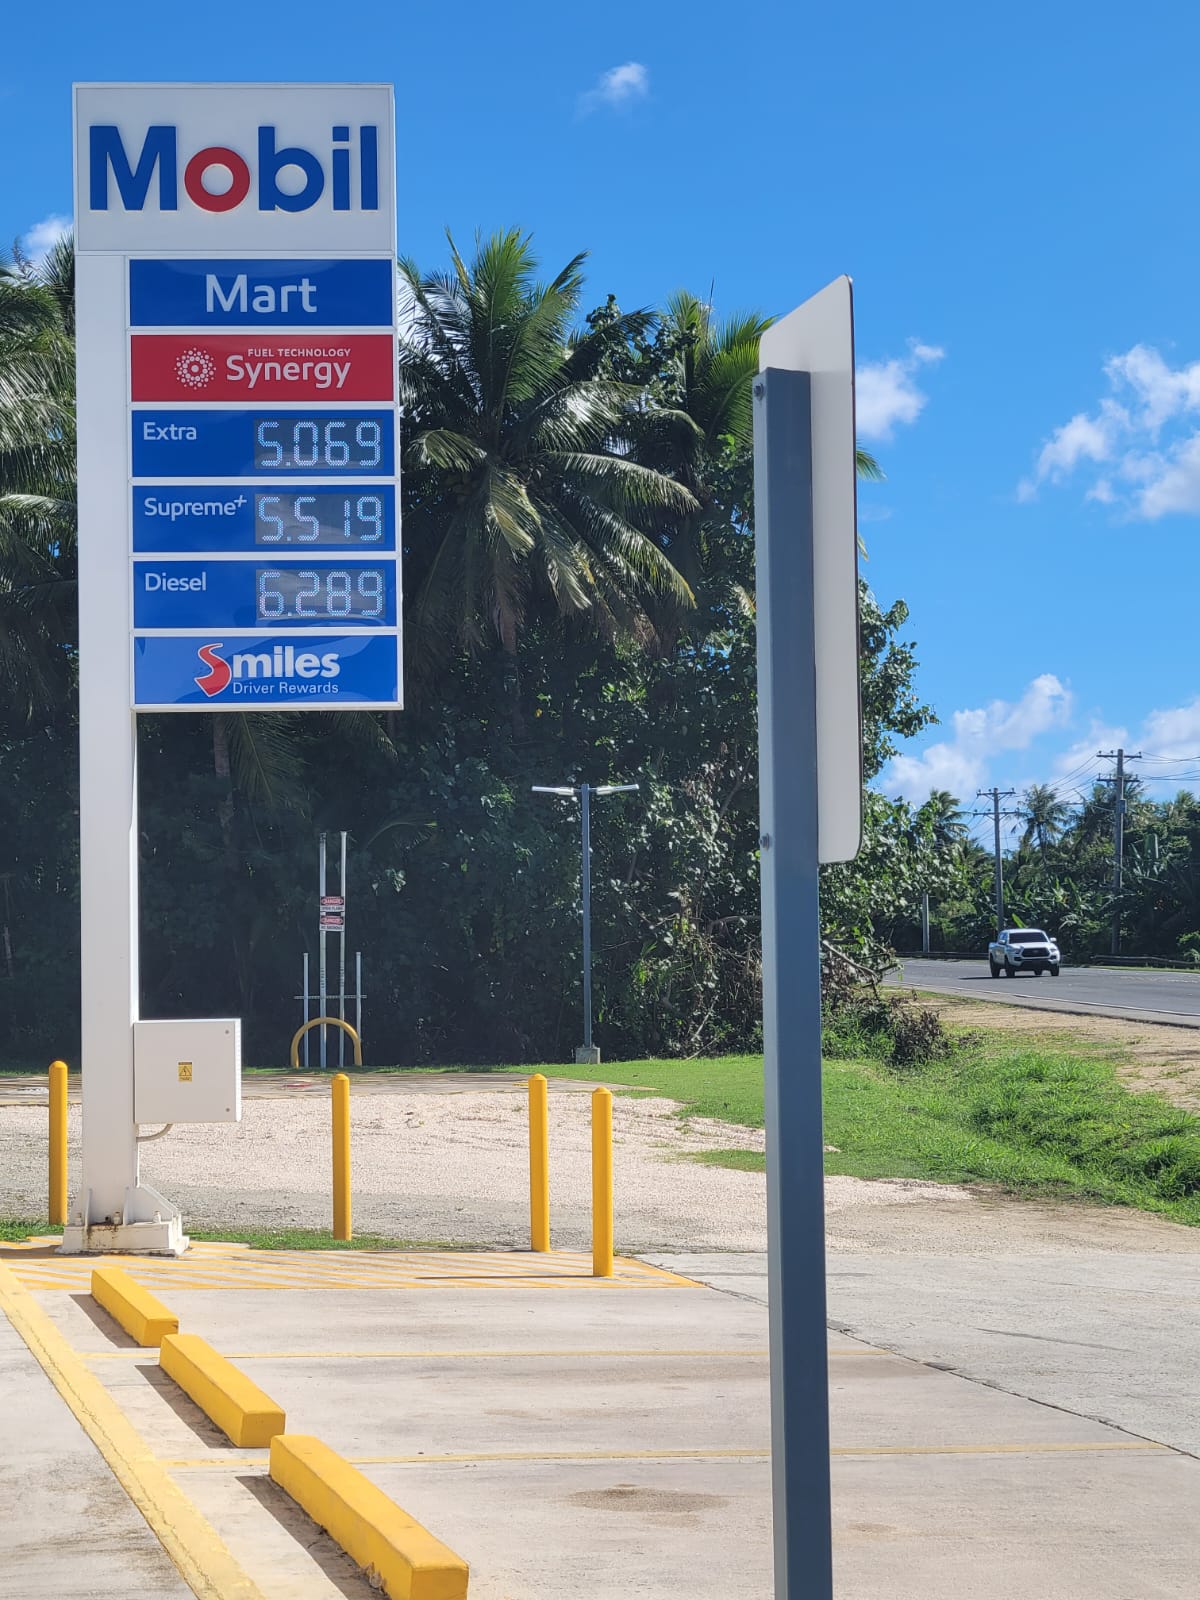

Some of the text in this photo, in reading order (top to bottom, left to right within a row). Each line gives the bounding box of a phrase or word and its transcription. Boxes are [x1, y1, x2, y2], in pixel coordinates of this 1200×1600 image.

[89, 125, 379, 213] Mobil
[205, 274, 317, 313] Mart
[226, 355, 351, 389] Synergy
[247, 348, 351, 357] FUEL TECHNOLOGY
[143, 421, 381, 466] Extra 5.069
[144, 495, 382, 541] Supreme+ 5.519
[144, 571, 383, 617] Diesel 6.289
[194, 642, 341, 698] Smiles
[232, 681, 339, 695] Driver Rewards
